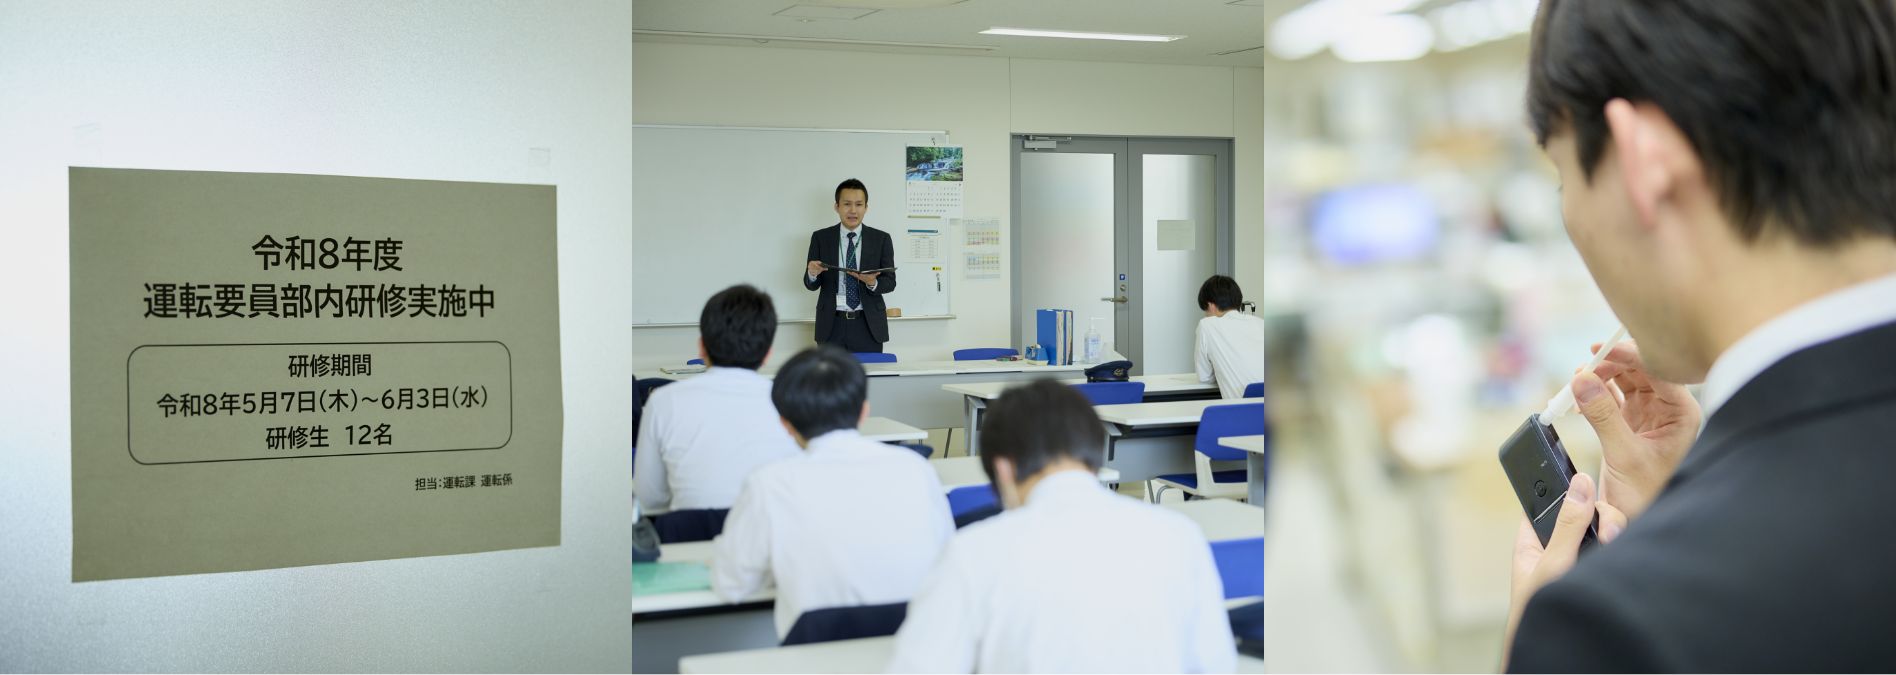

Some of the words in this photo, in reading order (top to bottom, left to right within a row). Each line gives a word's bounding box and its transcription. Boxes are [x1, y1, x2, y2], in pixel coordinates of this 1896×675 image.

[251, 234, 404, 272] 令和8年度
[143, 281, 495, 319] 運転要員部内研修実施中
[287, 353, 372, 379] 研修期間
[265, 424, 330, 451] 研修生
[345, 422, 393, 447] 12名
[480, 472, 513, 488] 運転係
